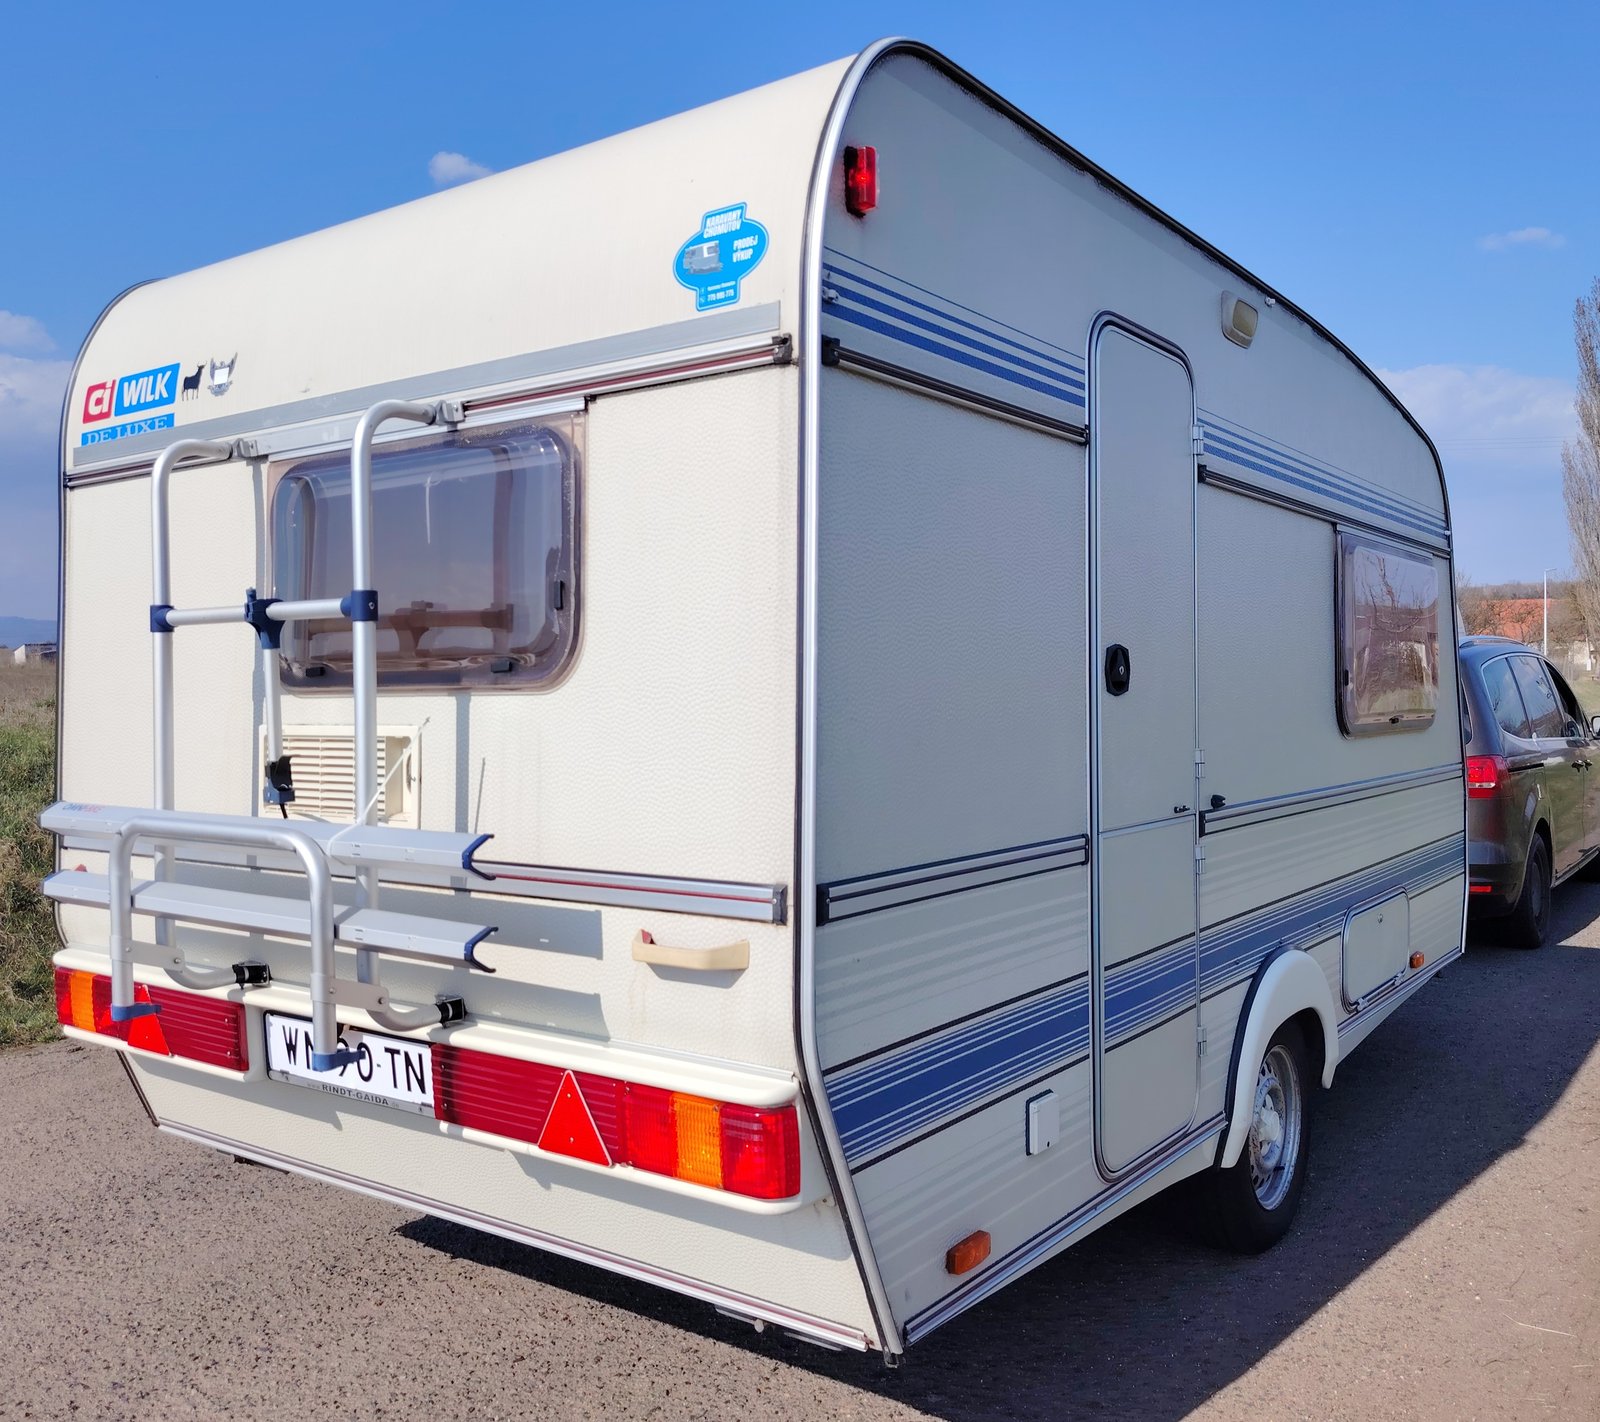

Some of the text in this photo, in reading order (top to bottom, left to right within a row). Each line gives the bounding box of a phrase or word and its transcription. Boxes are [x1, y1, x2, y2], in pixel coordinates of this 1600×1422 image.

[123, 370, 172, 408] WILK
[86, 416, 168, 446] DE LUXE
